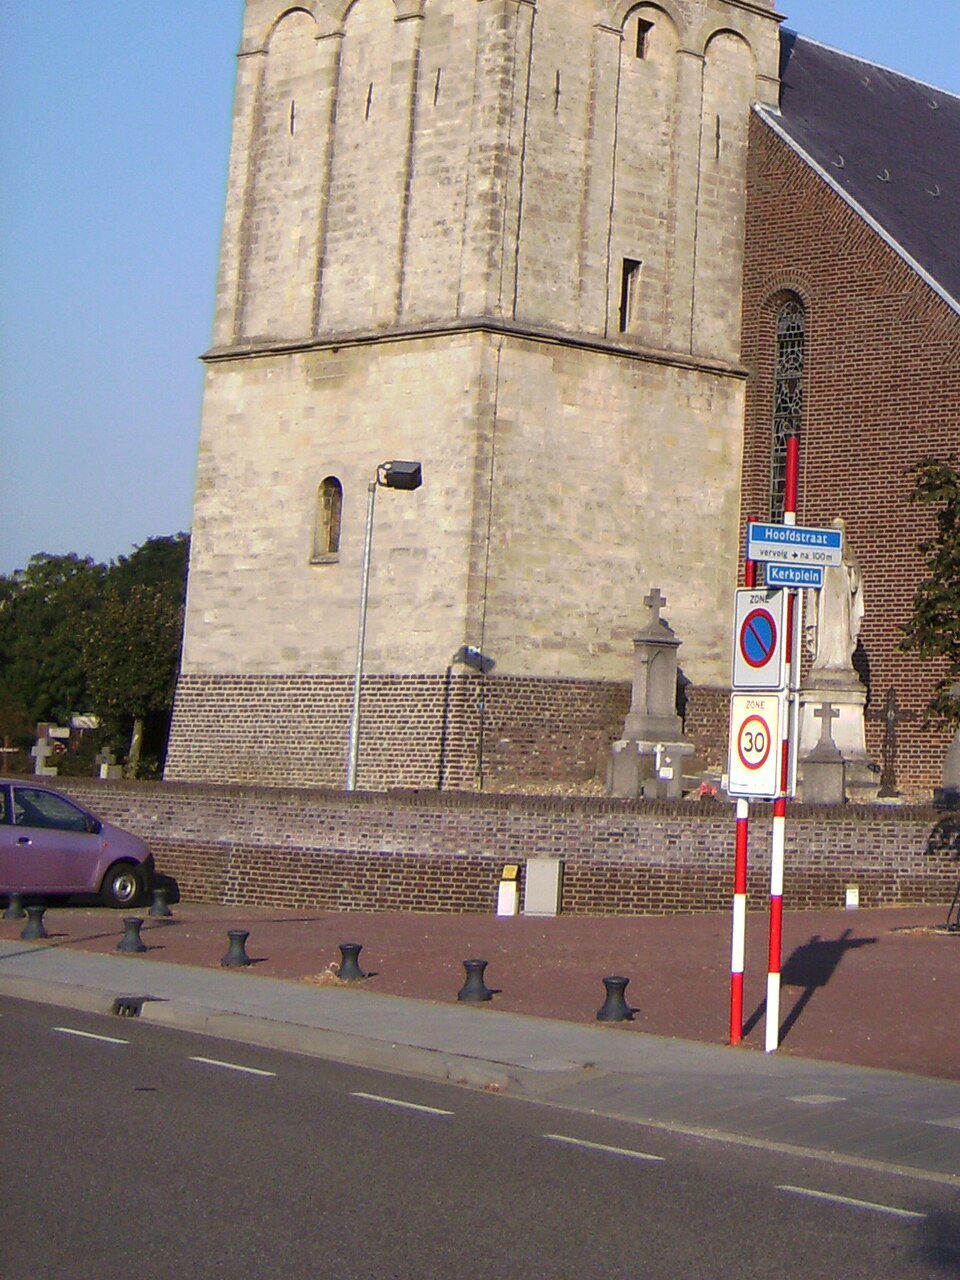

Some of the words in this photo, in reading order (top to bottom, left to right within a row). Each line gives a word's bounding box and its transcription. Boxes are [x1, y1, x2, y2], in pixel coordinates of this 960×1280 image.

[765, 528, 828, 544] Hoofdstraat
[760, 549, 788, 559] vervolg
[800, 552, 809, 560] na
[771, 567, 819, 582] Kerkplein
[749, 594, 770, 604] ZONE
[745, 700, 765, 709] ZONE
[743, 731, 765, 753] 30
